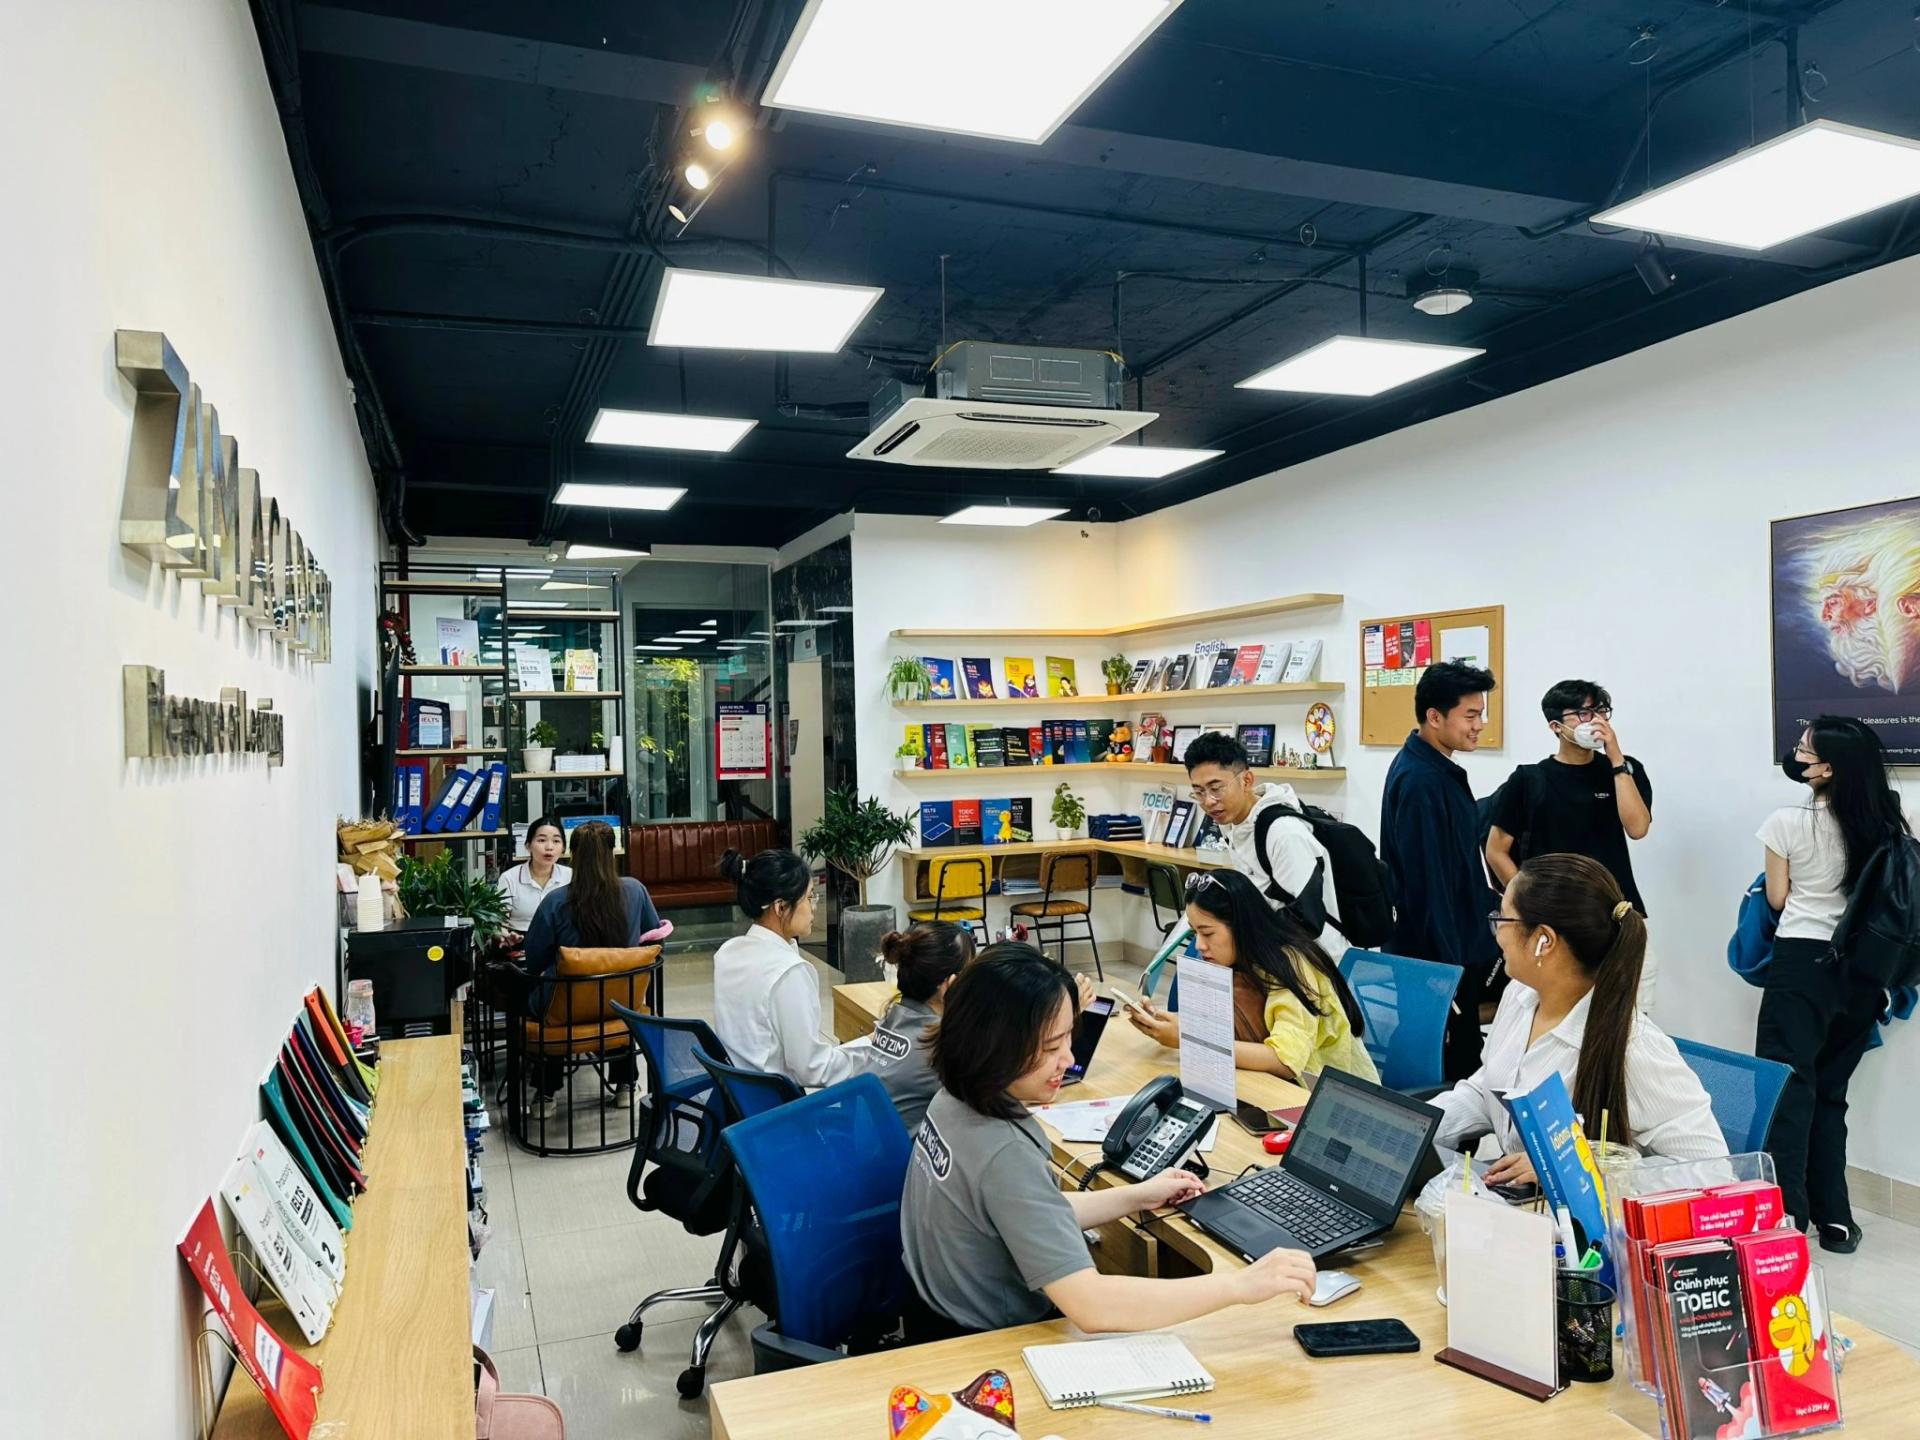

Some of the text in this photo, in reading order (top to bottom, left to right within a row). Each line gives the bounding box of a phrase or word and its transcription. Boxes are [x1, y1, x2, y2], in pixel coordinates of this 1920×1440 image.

[1195, 640, 1226, 656] English
[1900, 715, 1909, 724] is
[1142, 792, 1172, 809] TOEIC
[887, 1039, 907, 1055] ZIM
[289, 1185, 306, 1215] IELTS
[275, 1199, 294, 1226] Practicing
[260, 1240, 279, 1268] Practicing
[321, 1241, 336, 1265] 2
[314, 1260, 323, 1268] 2
[1673, 1275, 1729, 1291] Chinh phục
[1676, 1289, 1731, 1314] TOEIC
